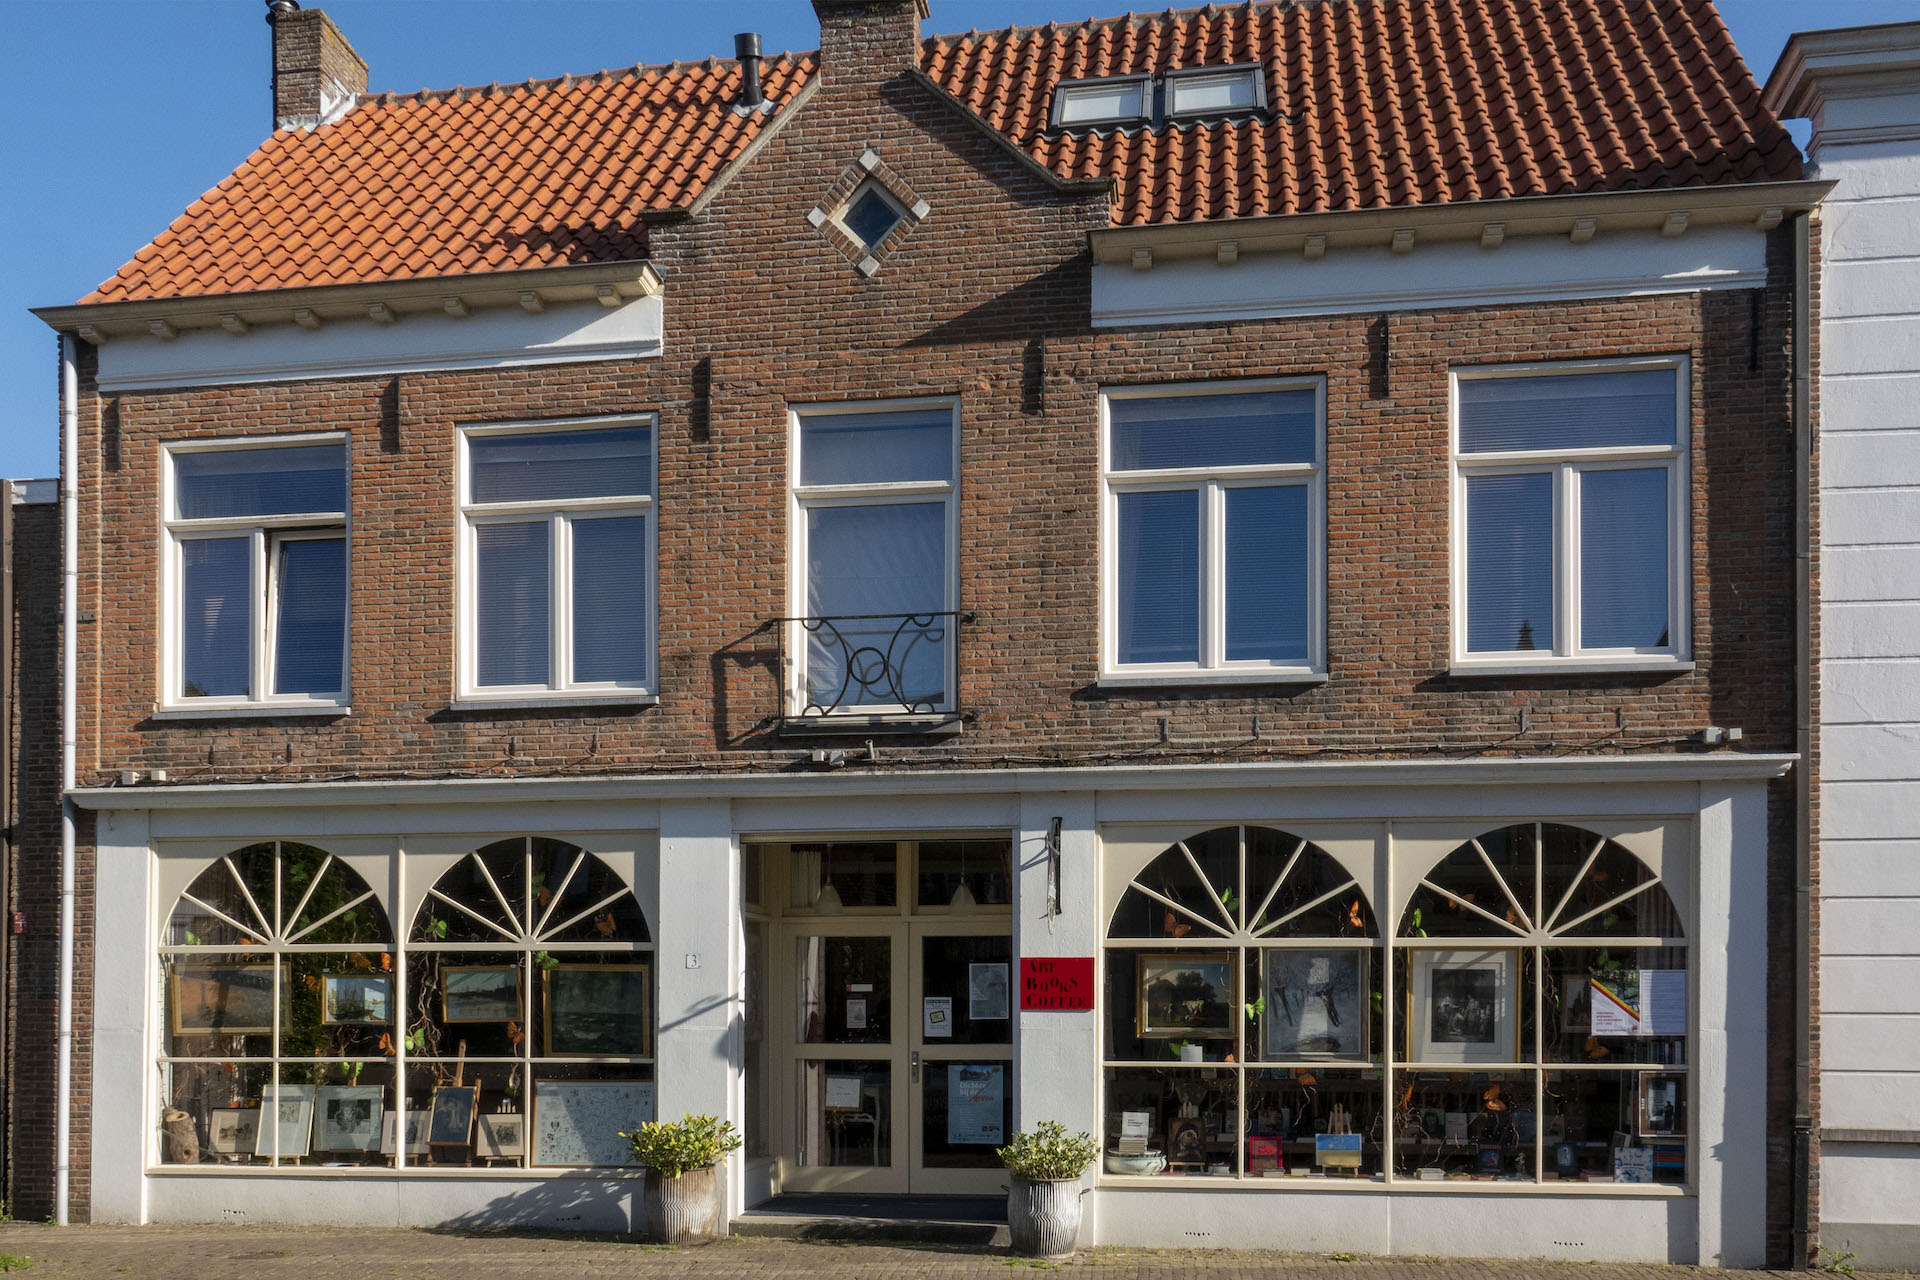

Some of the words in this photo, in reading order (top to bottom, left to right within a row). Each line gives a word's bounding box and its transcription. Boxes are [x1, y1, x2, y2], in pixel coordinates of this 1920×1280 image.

[1030, 961, 1056, 973] ART
[1026, 976, 1079, 993] BOOKS
[1026, 994, 1086, 1007] COFFEE
